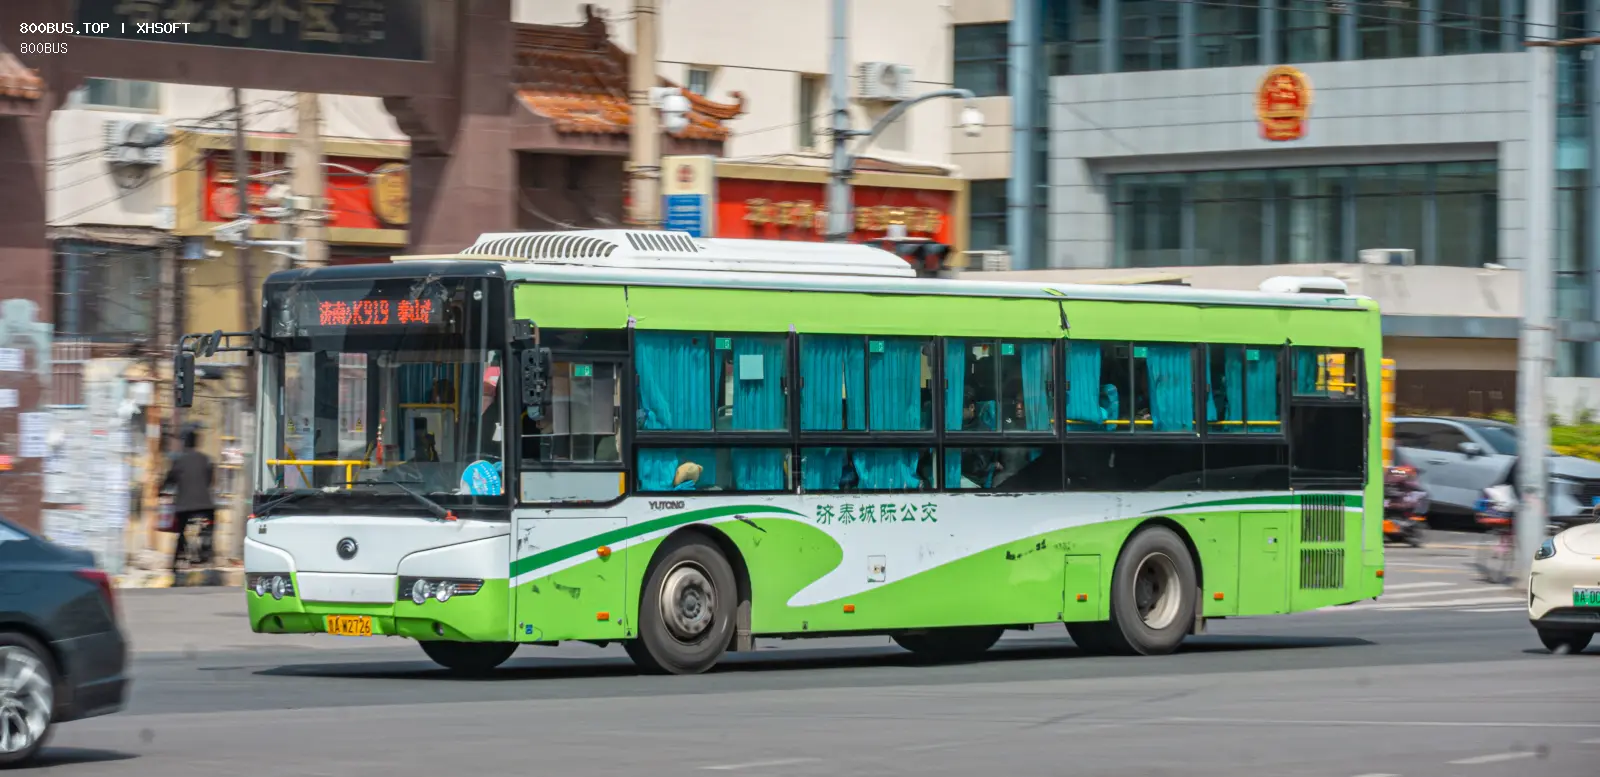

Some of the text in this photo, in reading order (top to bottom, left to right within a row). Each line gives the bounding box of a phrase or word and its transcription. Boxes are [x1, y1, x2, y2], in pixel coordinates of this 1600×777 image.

[648, 500, 686, 510] YUTONG
[816, 501, 938, 525] 济泰城际公交
